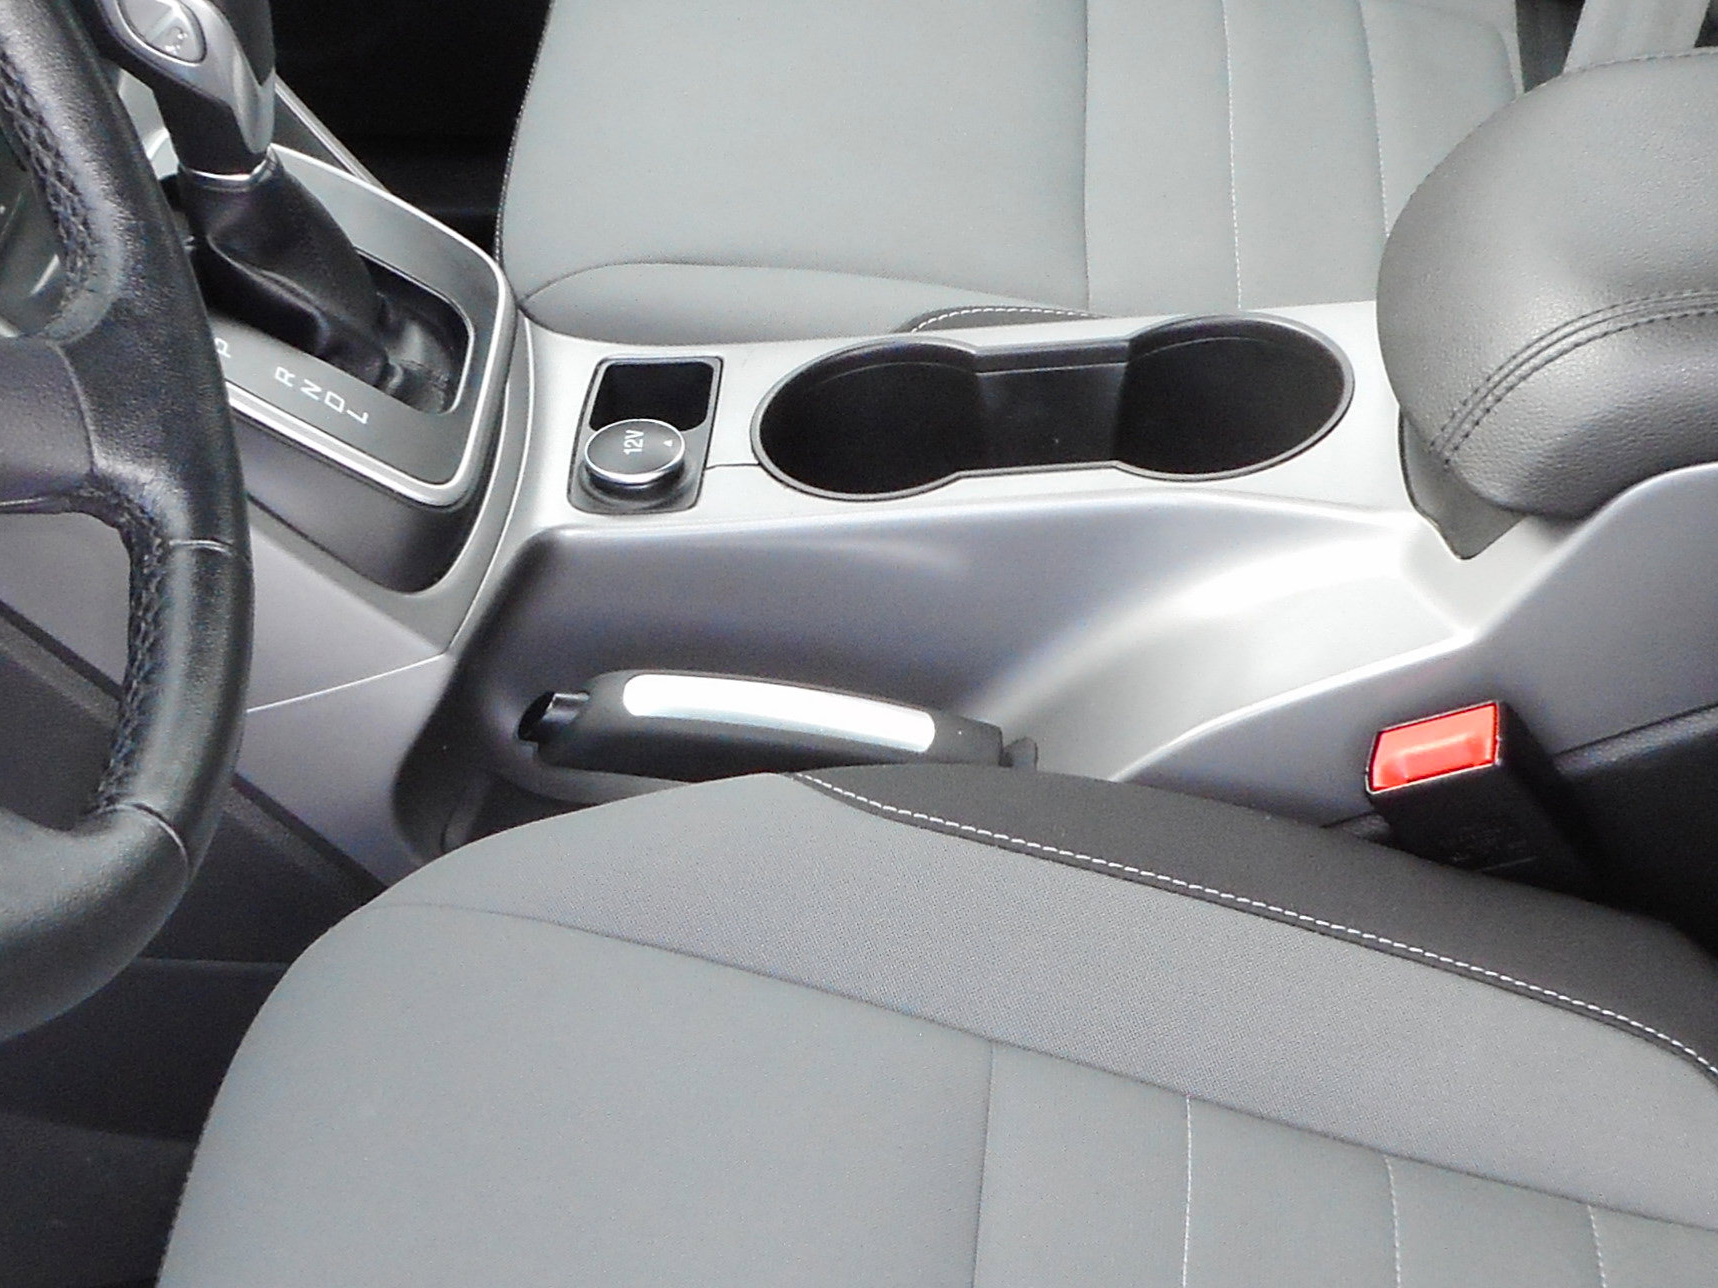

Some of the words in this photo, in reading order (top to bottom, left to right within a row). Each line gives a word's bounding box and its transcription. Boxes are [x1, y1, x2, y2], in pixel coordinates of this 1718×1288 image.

[214, 337, 231, 358] P
[275, 366, 296, 387] R
[300, 379, 322, 401] N
[324, 391, 345, 413] D
[347, 409, 369, 425] L
[623, 429, 644, 455] 12V
